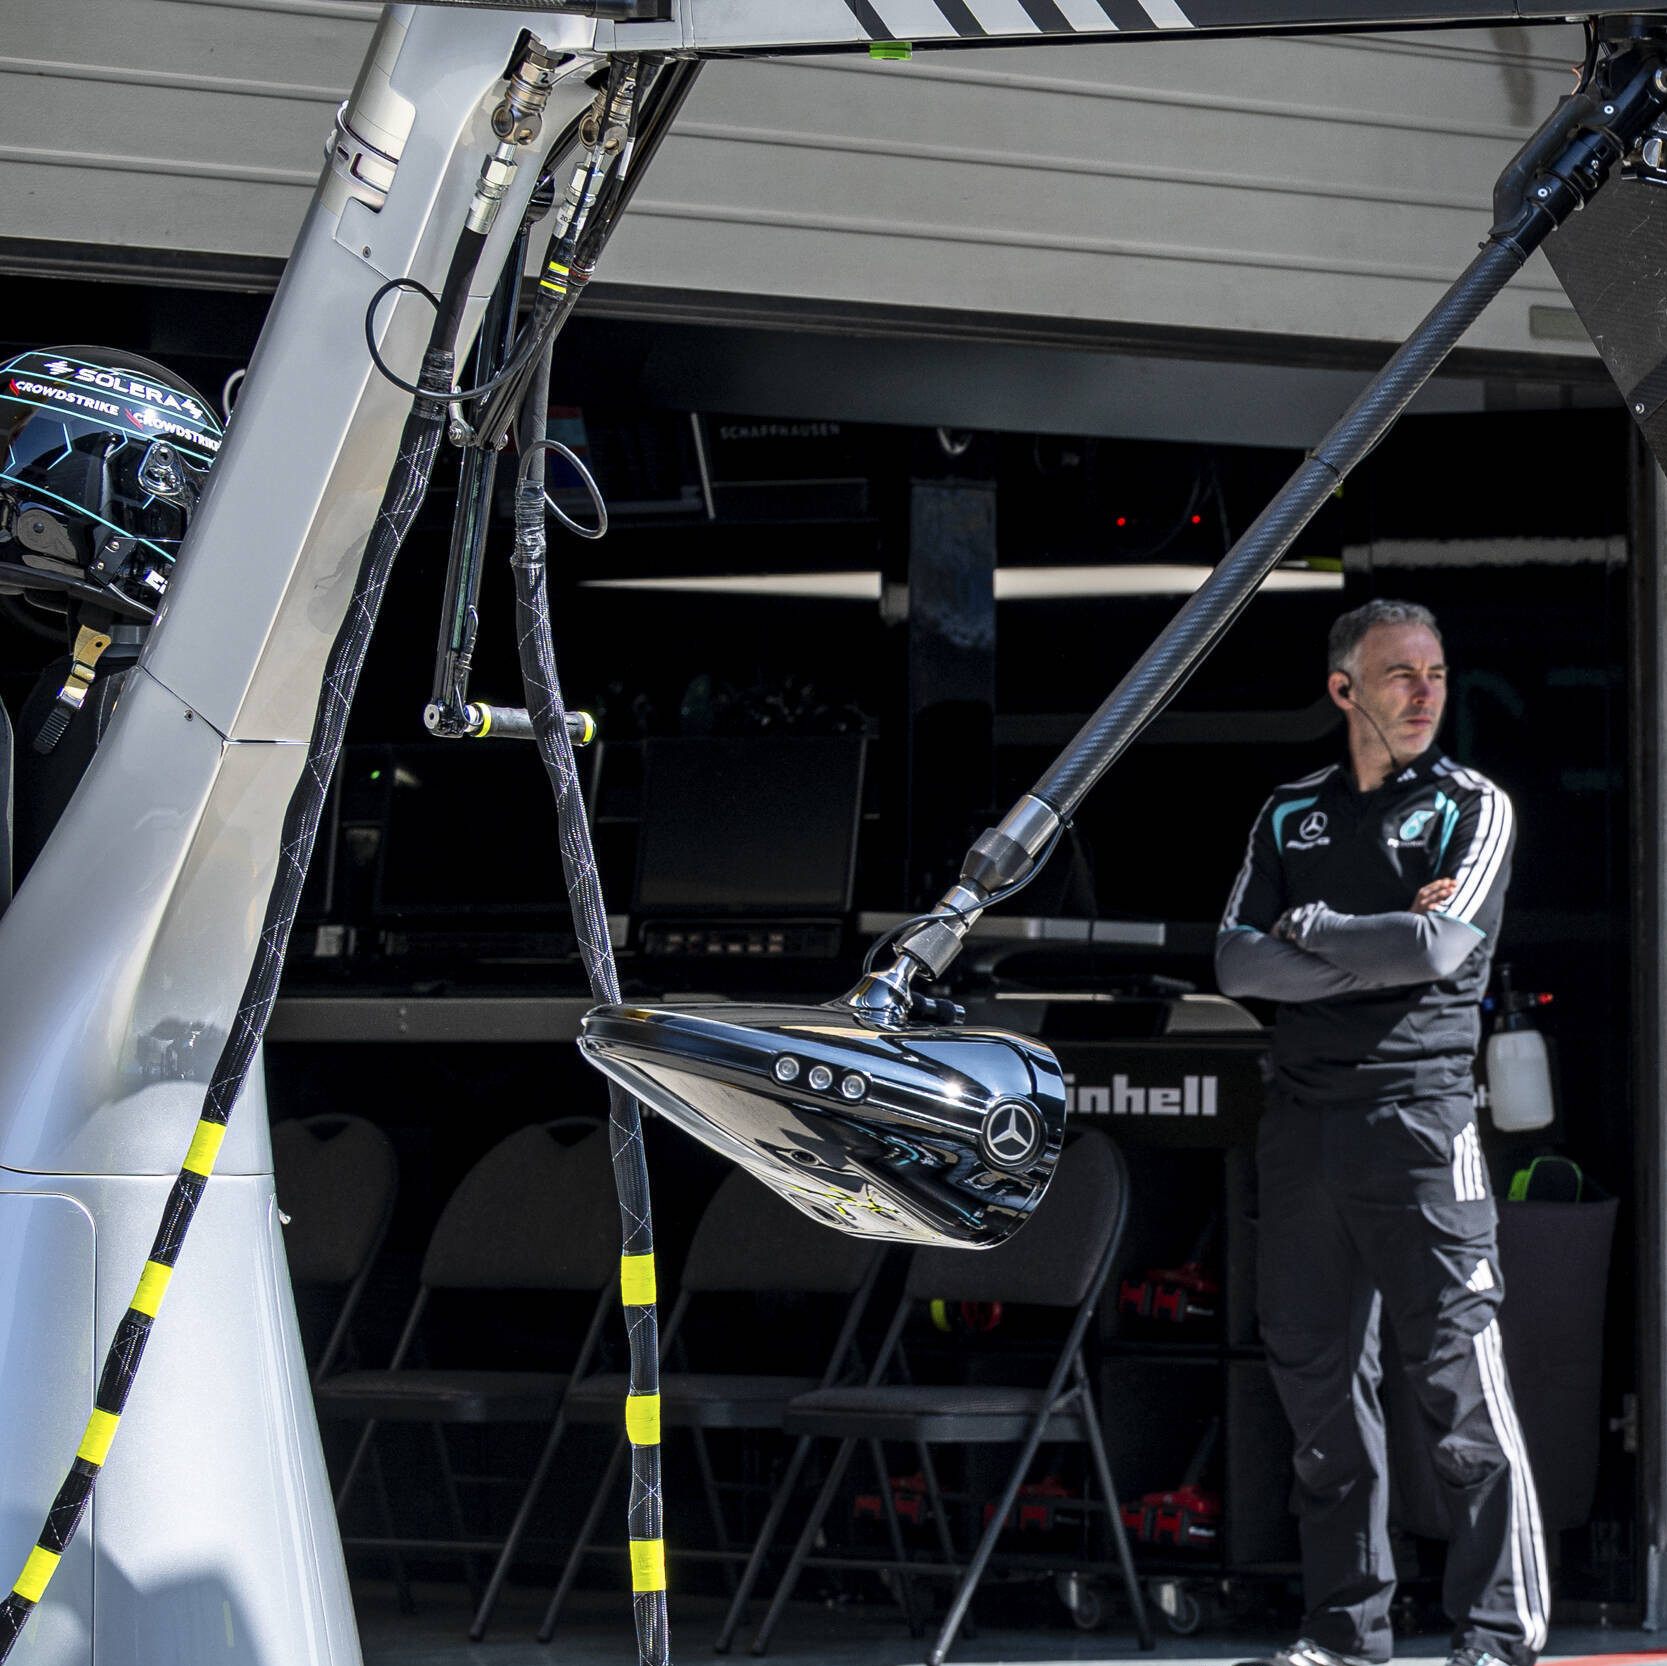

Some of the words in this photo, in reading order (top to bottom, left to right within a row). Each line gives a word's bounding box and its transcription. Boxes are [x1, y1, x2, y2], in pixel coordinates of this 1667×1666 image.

[15, 380, 120, 416] CROWDSTRIKE
[75, 368, 182, 411] SOLERA
[720, 422, 841, 440] SCHAFFHAUSEN
[1066, 1074, 1218, 1116] inhell
